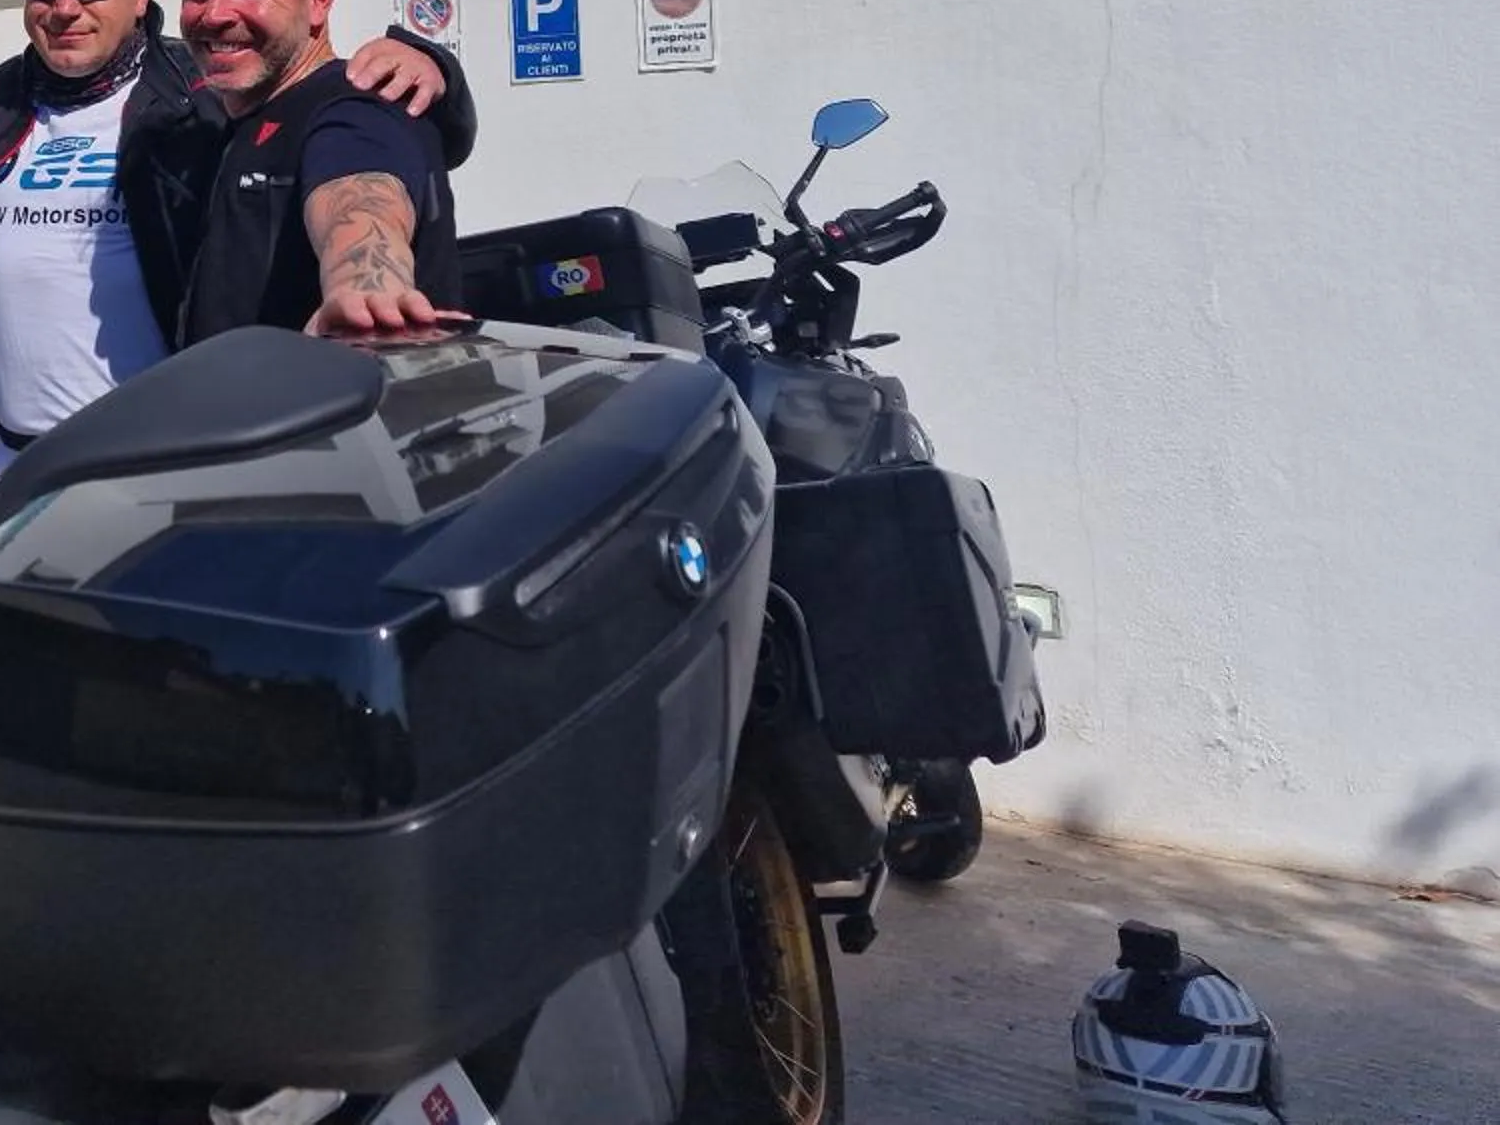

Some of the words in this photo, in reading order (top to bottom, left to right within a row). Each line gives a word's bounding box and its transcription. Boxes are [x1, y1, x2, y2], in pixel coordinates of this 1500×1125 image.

[517, 40, 577, 54] RISERVATO
[527, 63, 569, 76] CLIENTI
[12, 206, 128, 227] Motorspor
[557, 268, 584, 285] RO
